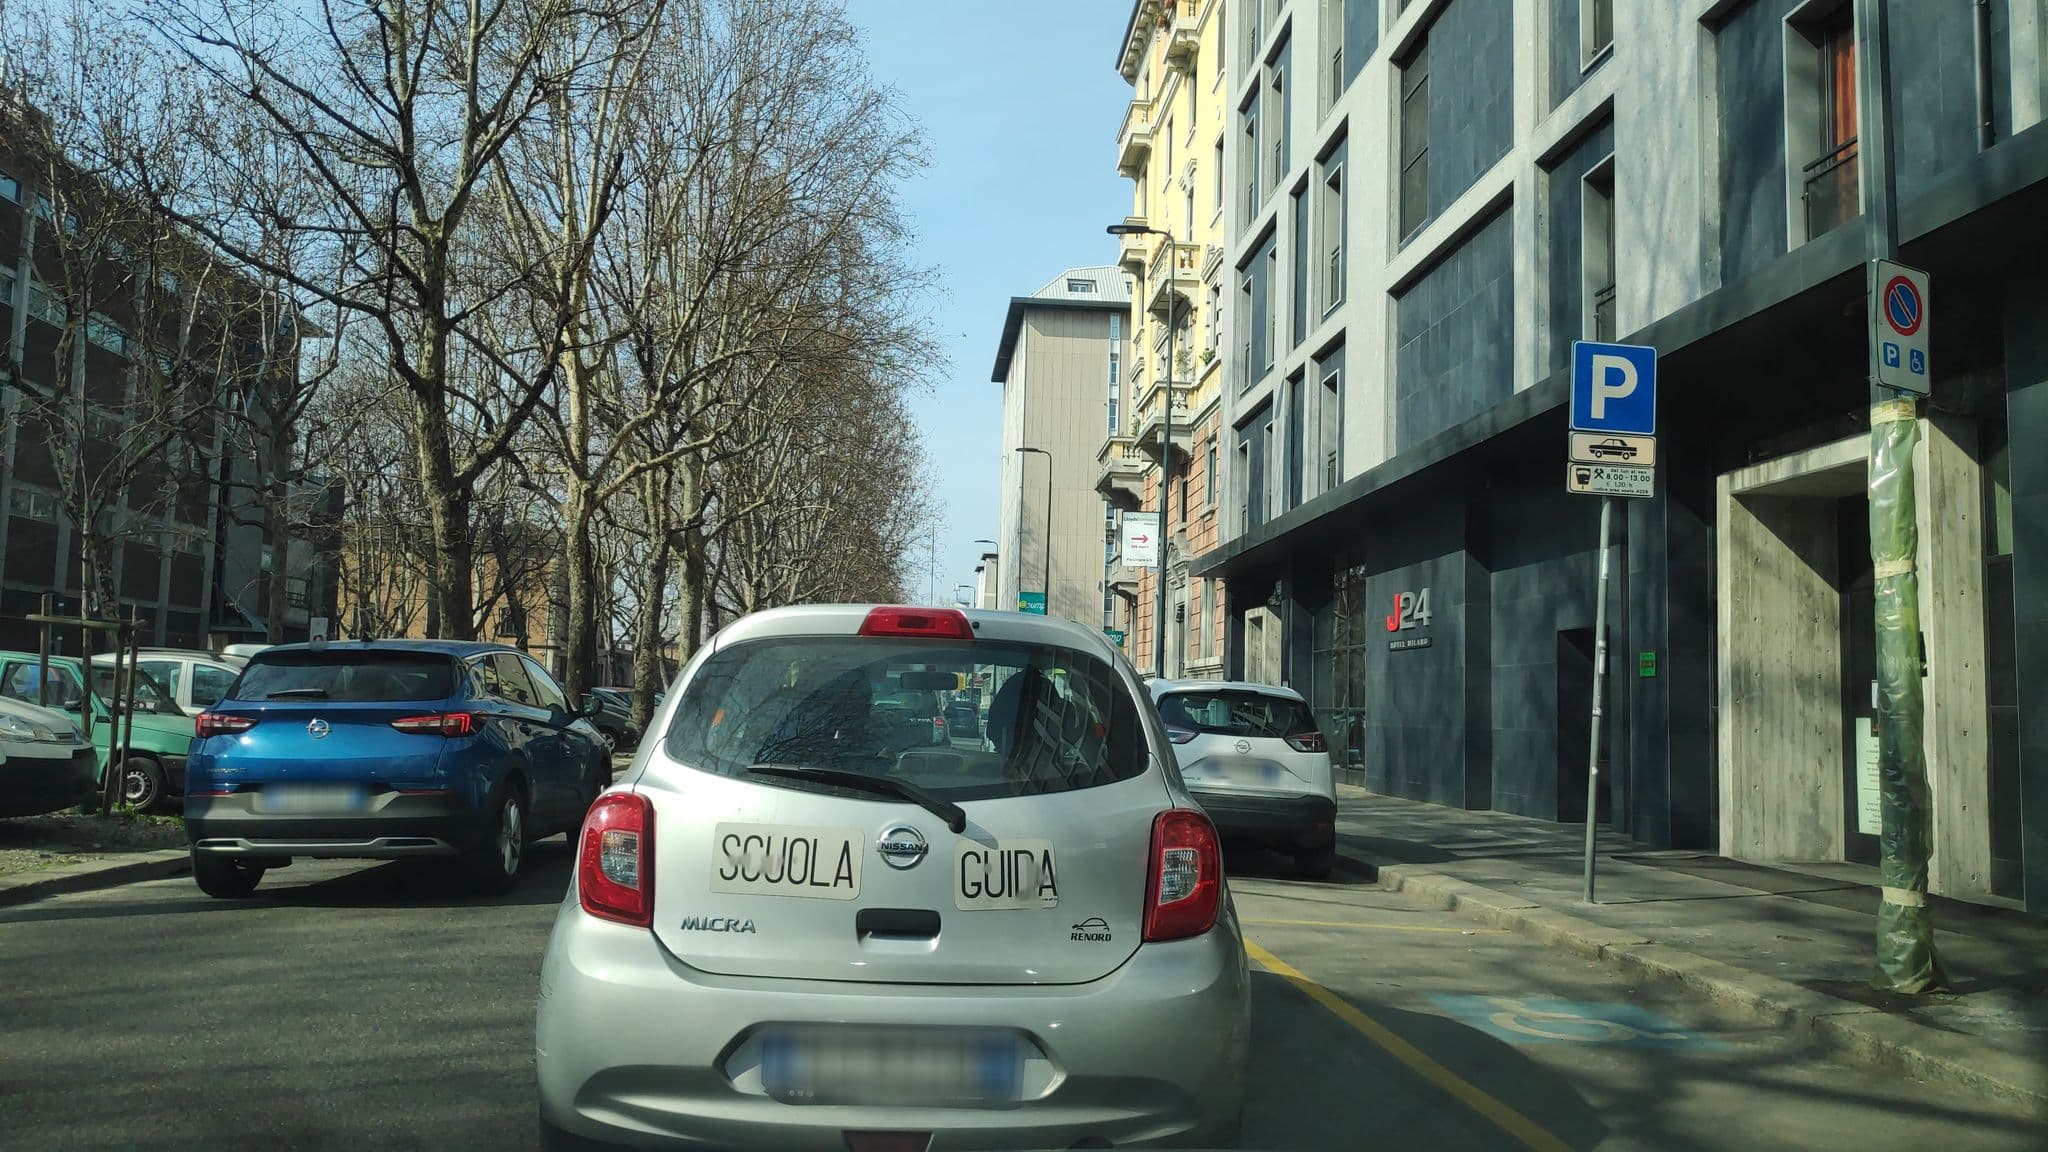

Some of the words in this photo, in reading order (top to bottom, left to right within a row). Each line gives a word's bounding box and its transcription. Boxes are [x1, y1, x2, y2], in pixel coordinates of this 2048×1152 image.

[1887, 346, 1897, 364] P
[1591, 354, 1638, 419] P
[1386, 588, 1432, 632] J24
[881, 842, 922, 851] NISSAN
[720, 833, 853, 888] SCUOLA
[681, 916, 756, 933] MICRA
[1070, 932, 1112, 941] RENORD
